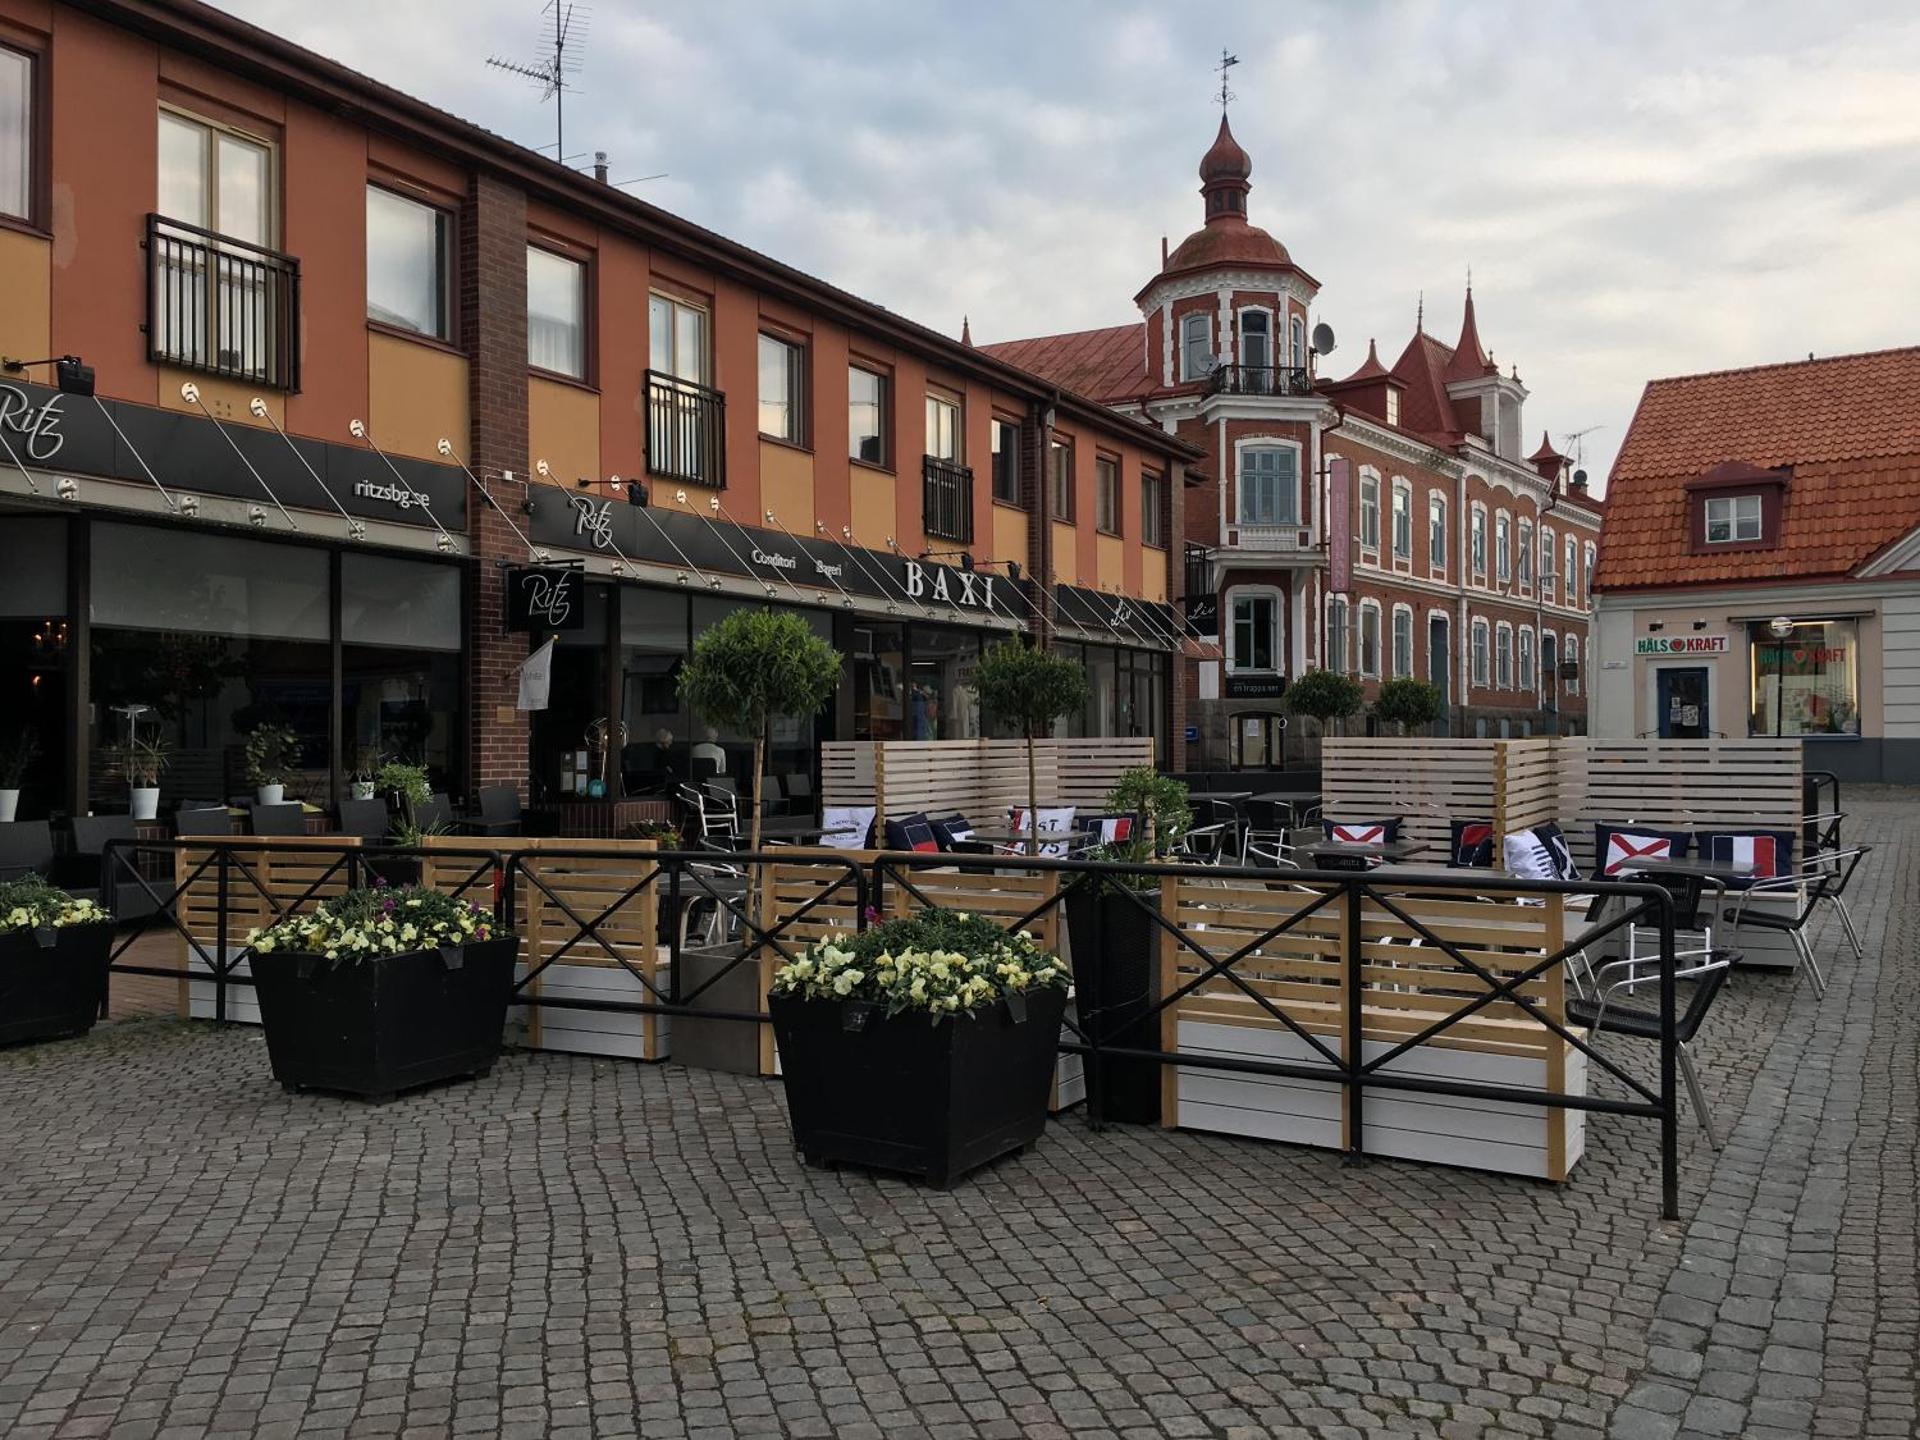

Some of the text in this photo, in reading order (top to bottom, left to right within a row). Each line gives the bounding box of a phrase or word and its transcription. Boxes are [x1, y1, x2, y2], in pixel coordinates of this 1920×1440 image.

[0, 384, 65, 460] Ritz
[354, 480, 430, 508] ritzsbg.se
[569, 497, 613, 549] Ritz
[521, 570, 571, 626] Ritz
[904, 561, 994, 609] BAXI
